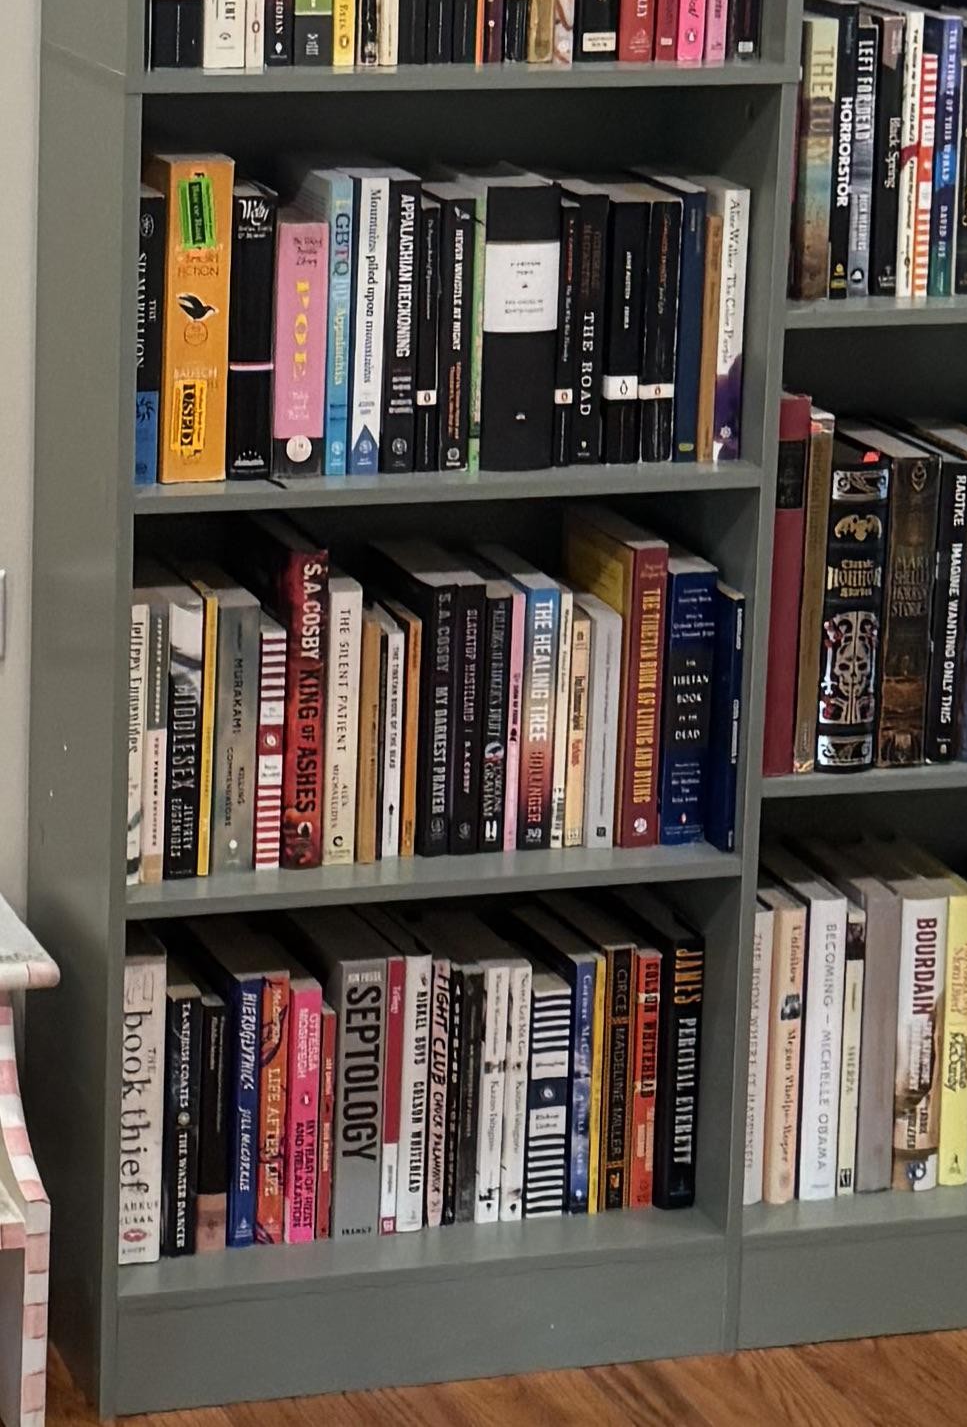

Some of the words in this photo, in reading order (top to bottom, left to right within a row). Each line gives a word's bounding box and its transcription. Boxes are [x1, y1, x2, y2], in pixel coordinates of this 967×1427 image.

[858, 40, 873, 72] LEFT
[856, 77, 871, 105] FOR
[855, 108, 869, 140] DEAD
[889, 117, 901, 148] Black
[885, 151, 898, 188] Spring
[369, 189, 381, 252] Mountains
[397, 194, 414, 282] APPALACHIAN
[366, 255, 379, 285] piled
[364, 287, 377, 317] upon
[396, 284, 412, 357] RECKONING
[363, 321, 375, 383] mountains
[583, 312, 595, 352] THE
[580, 362, 593, 415] ROAD
[953, 475, 966, 526] RADTKE
[949, 543, 962, 596] IMAGINE
[339, 609, 350, 634] THE
[535, 600, 553, 630] THE
[643, 589, 661, 610] THE
[640, 613, 660, 658] TIBETAN
[945, 600, 959, 657] WANTING
[337, 642, 350, 687] SILENT
[532, 634, 551, 699] HEALING
[639, 661, 656, 689] BOOK
[942, 662, 955, 693] ONLY
[232, 658, 243, 734] MURAKAMI
[298, 669, 319, 720] KING
[435, 686, 448, 707] MY
[637, 692, 655, 706] OF
[940, 695, 953, 723] THIS
[301, 724, 314, 742] OF
[337, 695, 348, 753] PATIENT
[433, 710, 448, 764] DARKEST
[530, 703, 549, 741] TREE
[636, 708, 654, 744] LIVING
[296, 746, 316, 813] ASHES
[635, 747, 652, 767] AND
[432, 767, 446, 814] PRAYER
[633, 770, 651, 803] DYING
[675, 949, 702, 1004] JAMES
[822, 924, 837, 1007] BECOMING
[912, 918, 937, 1015] BOURDAIN
[434, 975, 449, 1034] FIGHT
[615, 969, 628, 1013] CIRCE
[123, 1010, 152, 1100] book
[343, 987, 381, 1161] SEPTOLOGY
[432, 1038, 446, 1086] CLUB
[613, 1028, 626, 1101] MADELINE
[676, 1018, 696, 1091] PERCIVAL
[819, 1030, 832, 1106] MICHELLE
[267, 1068, 280, 1103] LIFE
[265, 1108, 279, 1156] AFTER
[433, 1092, 444, 1128] CHUCK
[611, 1108, 624, 1156] MILLER
[674, 1097, 695, 1164] EVERETT
[120, 1109, 149, 1192] thief
[816, 1113, 829, 1170] OBAMA
[265, 1162, 278, 1197] LIFE
